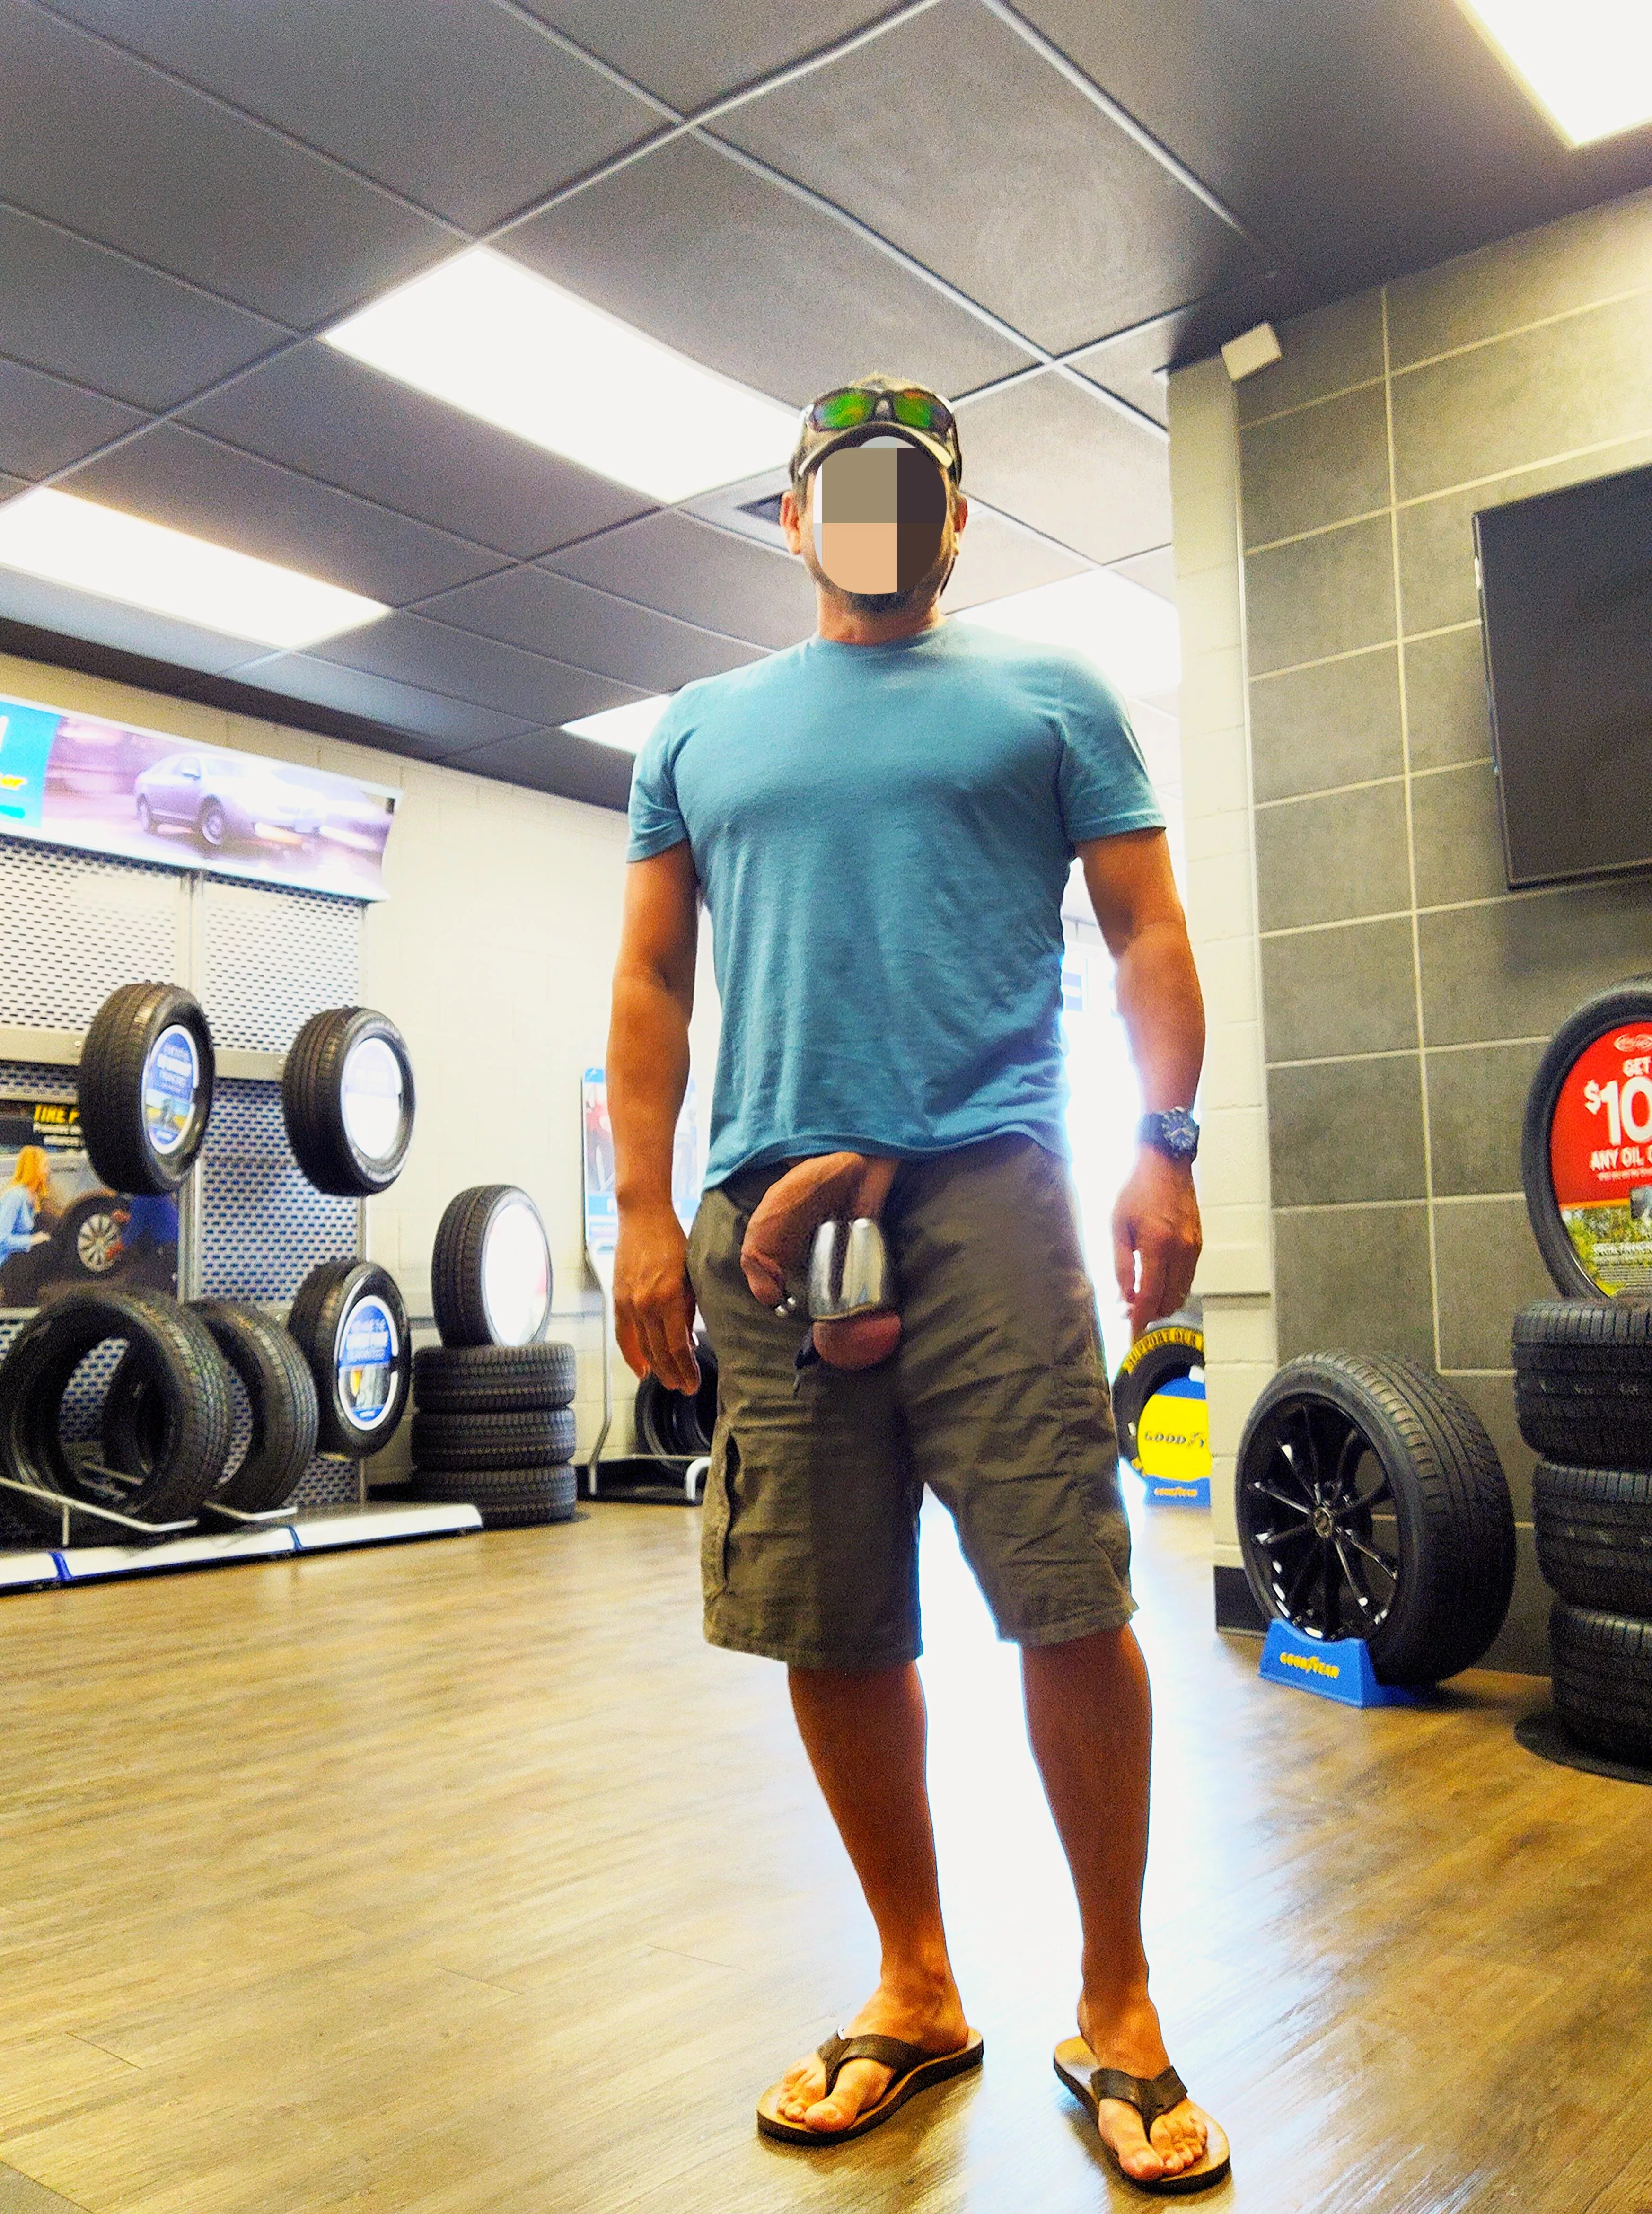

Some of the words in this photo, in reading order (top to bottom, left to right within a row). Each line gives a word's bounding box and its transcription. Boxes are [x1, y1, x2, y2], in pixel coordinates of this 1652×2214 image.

[1623, 1056, 1651, 1077] GET
[1584, 1075, 1652, 1146] $10
[1590, 1148, 1618, 1171] ANY
[1620, 1146, 1644, 1168] OIL
